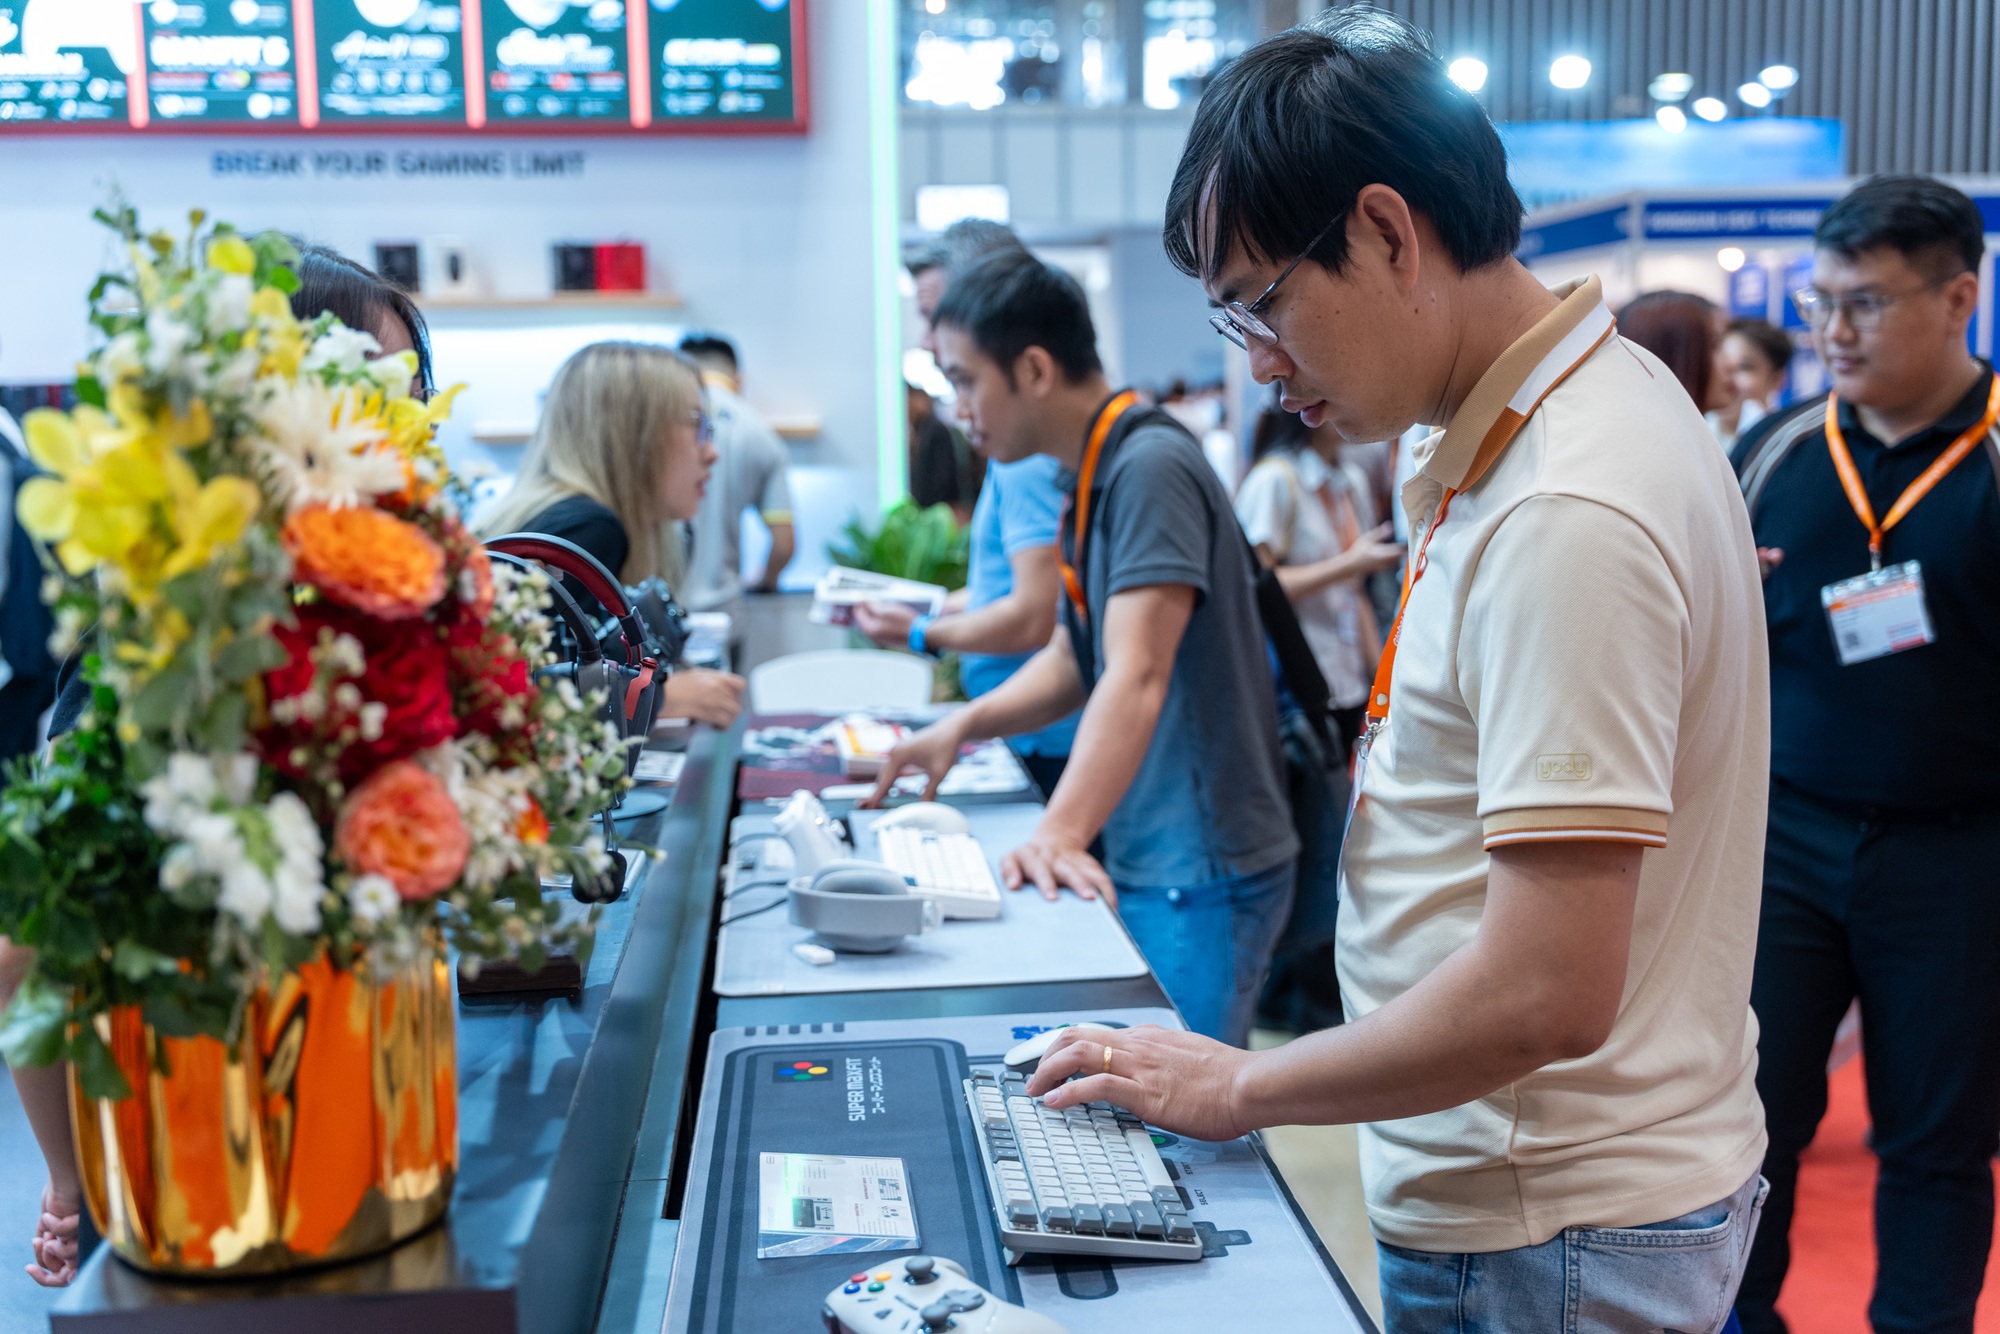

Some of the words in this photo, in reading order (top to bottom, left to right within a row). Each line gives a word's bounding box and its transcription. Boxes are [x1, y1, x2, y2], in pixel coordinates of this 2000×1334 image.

[212, 151, 299, 176] BREAK
[314, 151, 387, 176] YOUR
[399, 151, 505, 176] GAMING
[510, 151, 584, 176] LIMIT
[847, 1090, 866, 1121] SUPER
[1194, 1189, 1208, 1206] SELECT
